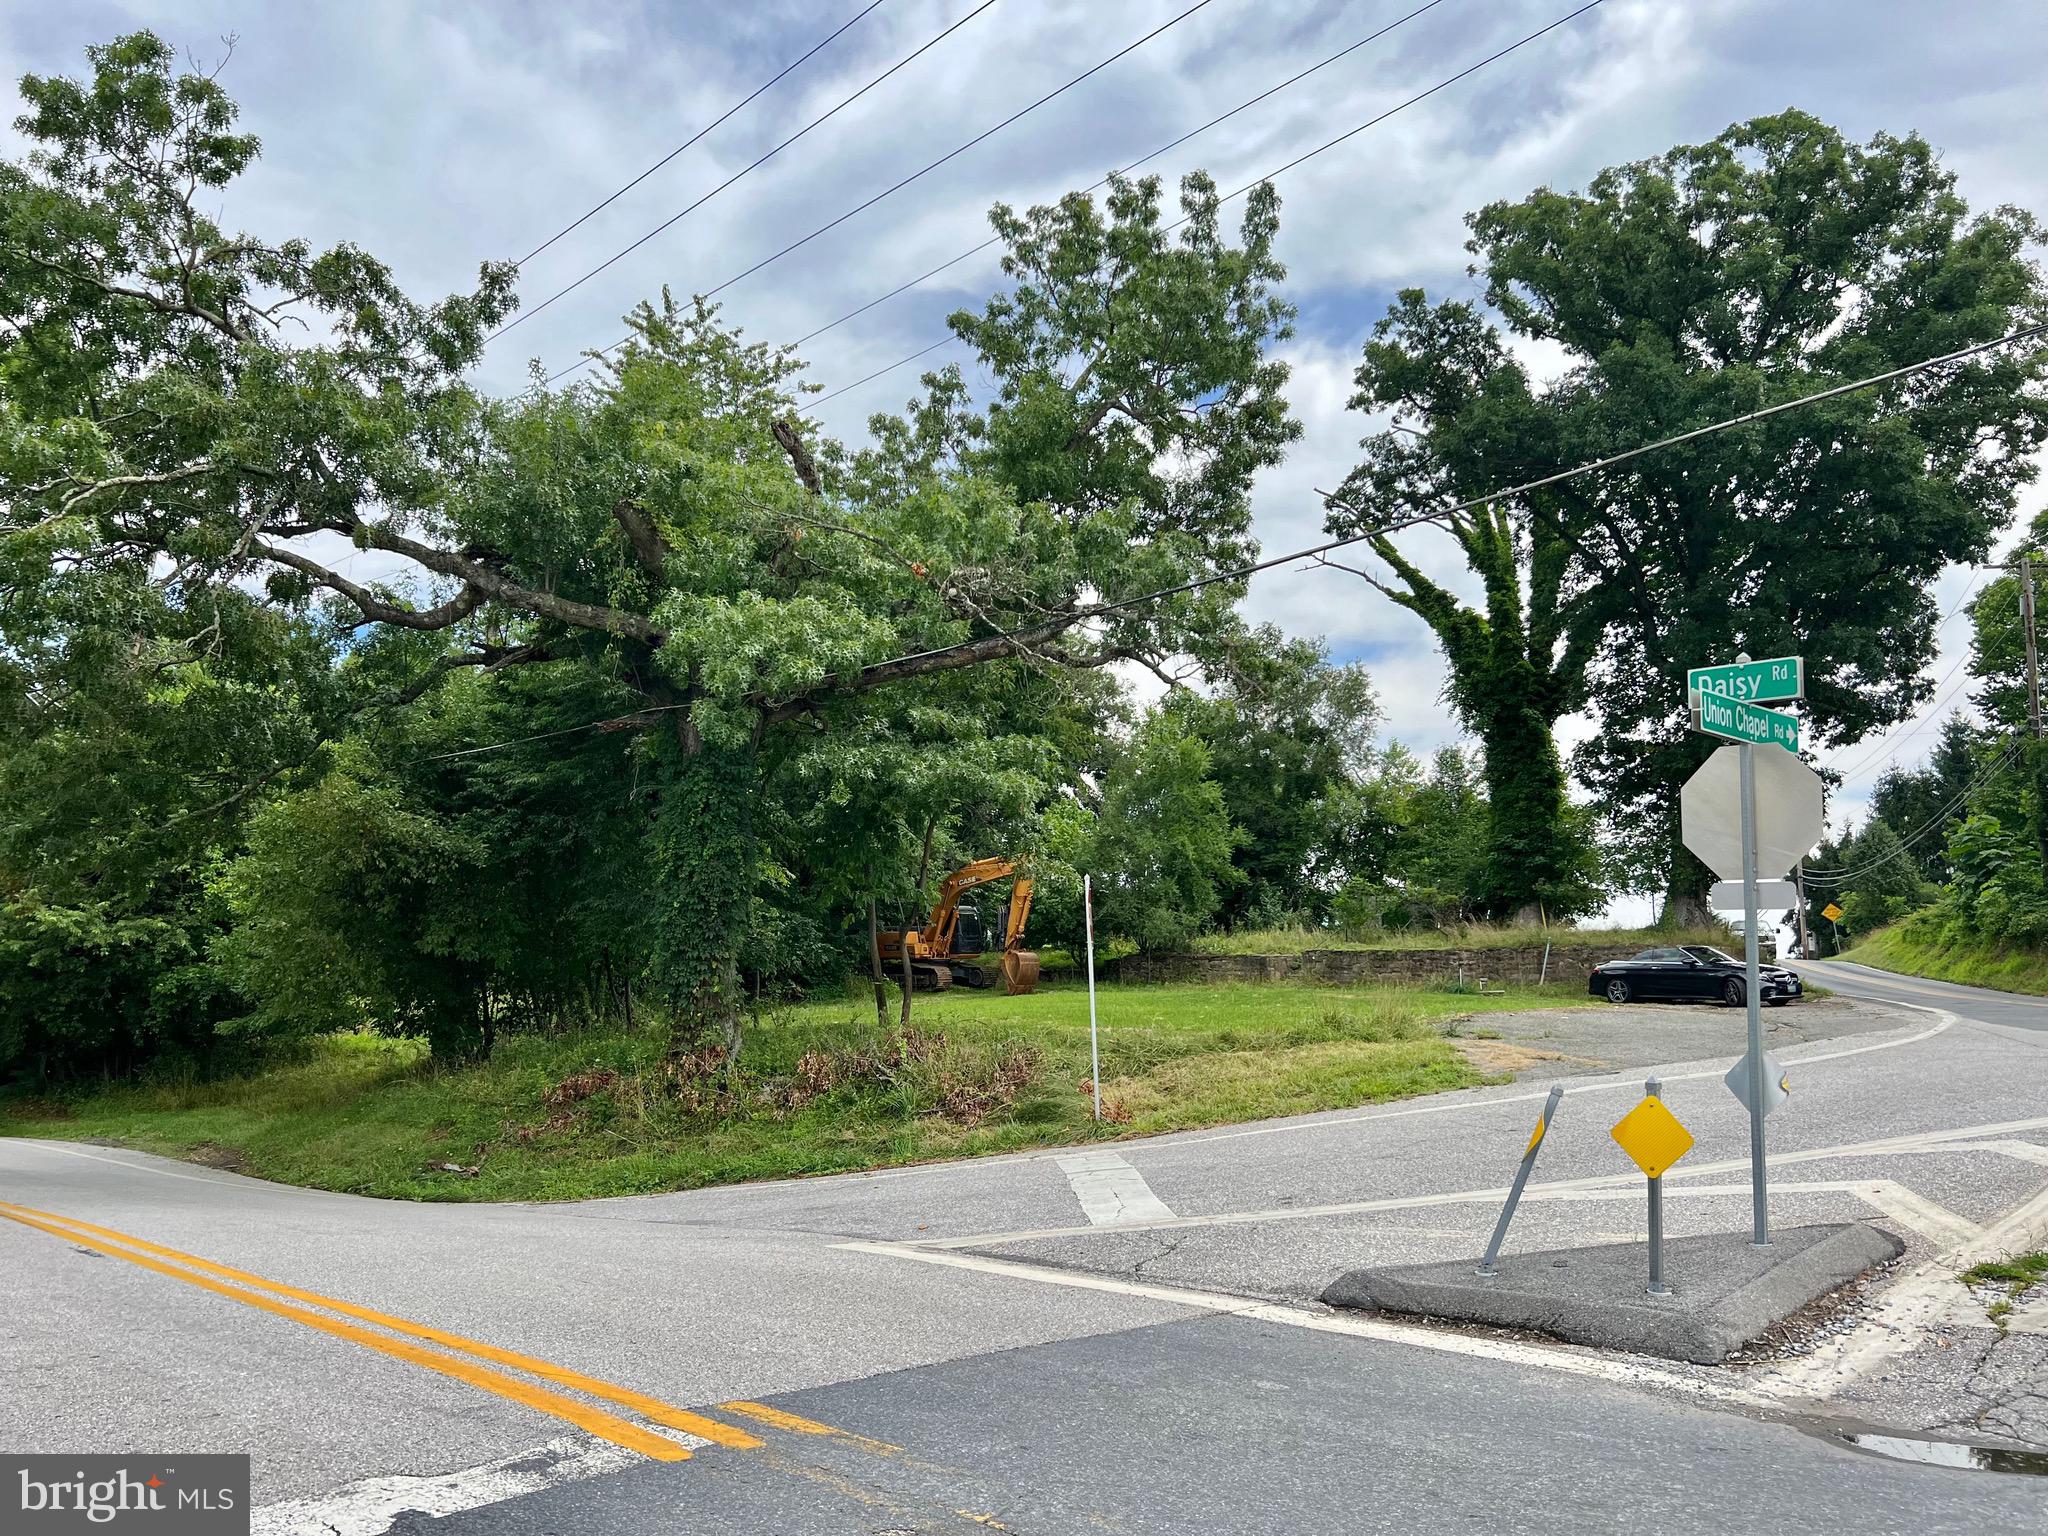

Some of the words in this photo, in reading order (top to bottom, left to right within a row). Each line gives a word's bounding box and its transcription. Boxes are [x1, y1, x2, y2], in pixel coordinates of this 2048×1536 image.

[1698, 672, 1762, 698] Daisy
[1772, 664, 1788, 681] Rd
[1703, 695, 1733, 729] Union
[1735, 705, 1770, 740] Chapel
[1774, 723, 1784, 739] Rd
[958, 876, 976, 885] CASE
